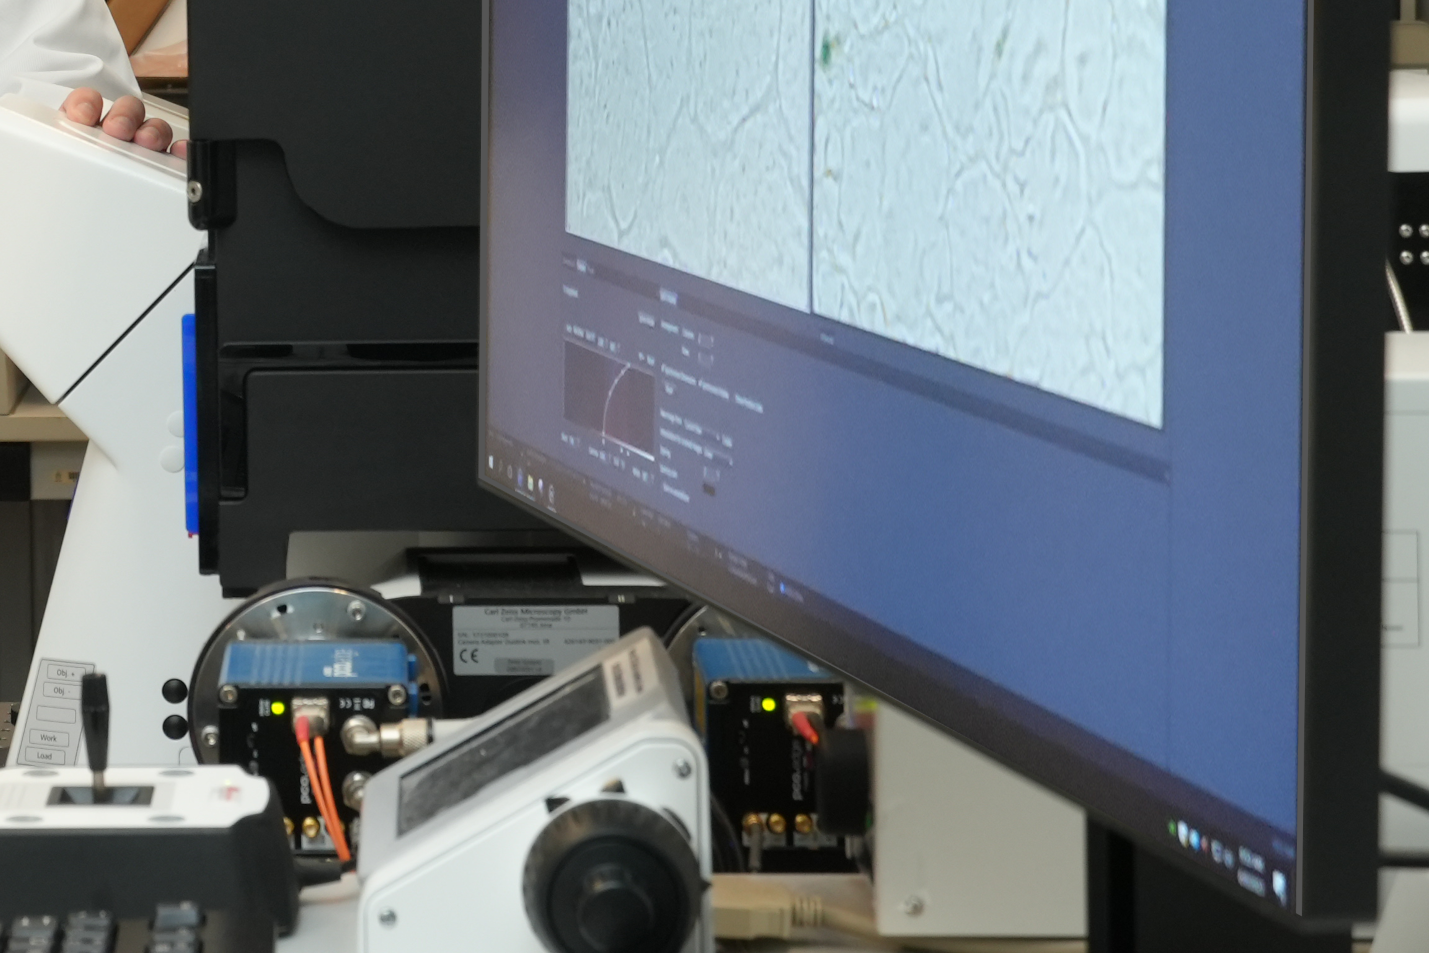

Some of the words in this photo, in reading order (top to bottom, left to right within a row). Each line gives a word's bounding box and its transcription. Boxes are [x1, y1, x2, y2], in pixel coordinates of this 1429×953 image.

[484, 608, 499, 616] Carl
[501, 608, 518, 616] Zeiss
[56, 669, 68, 678] Obj
[53, 687, 65, 696] Obj
[40, 734, 57, 742] Work
[37, 752, 53, 760] Load
